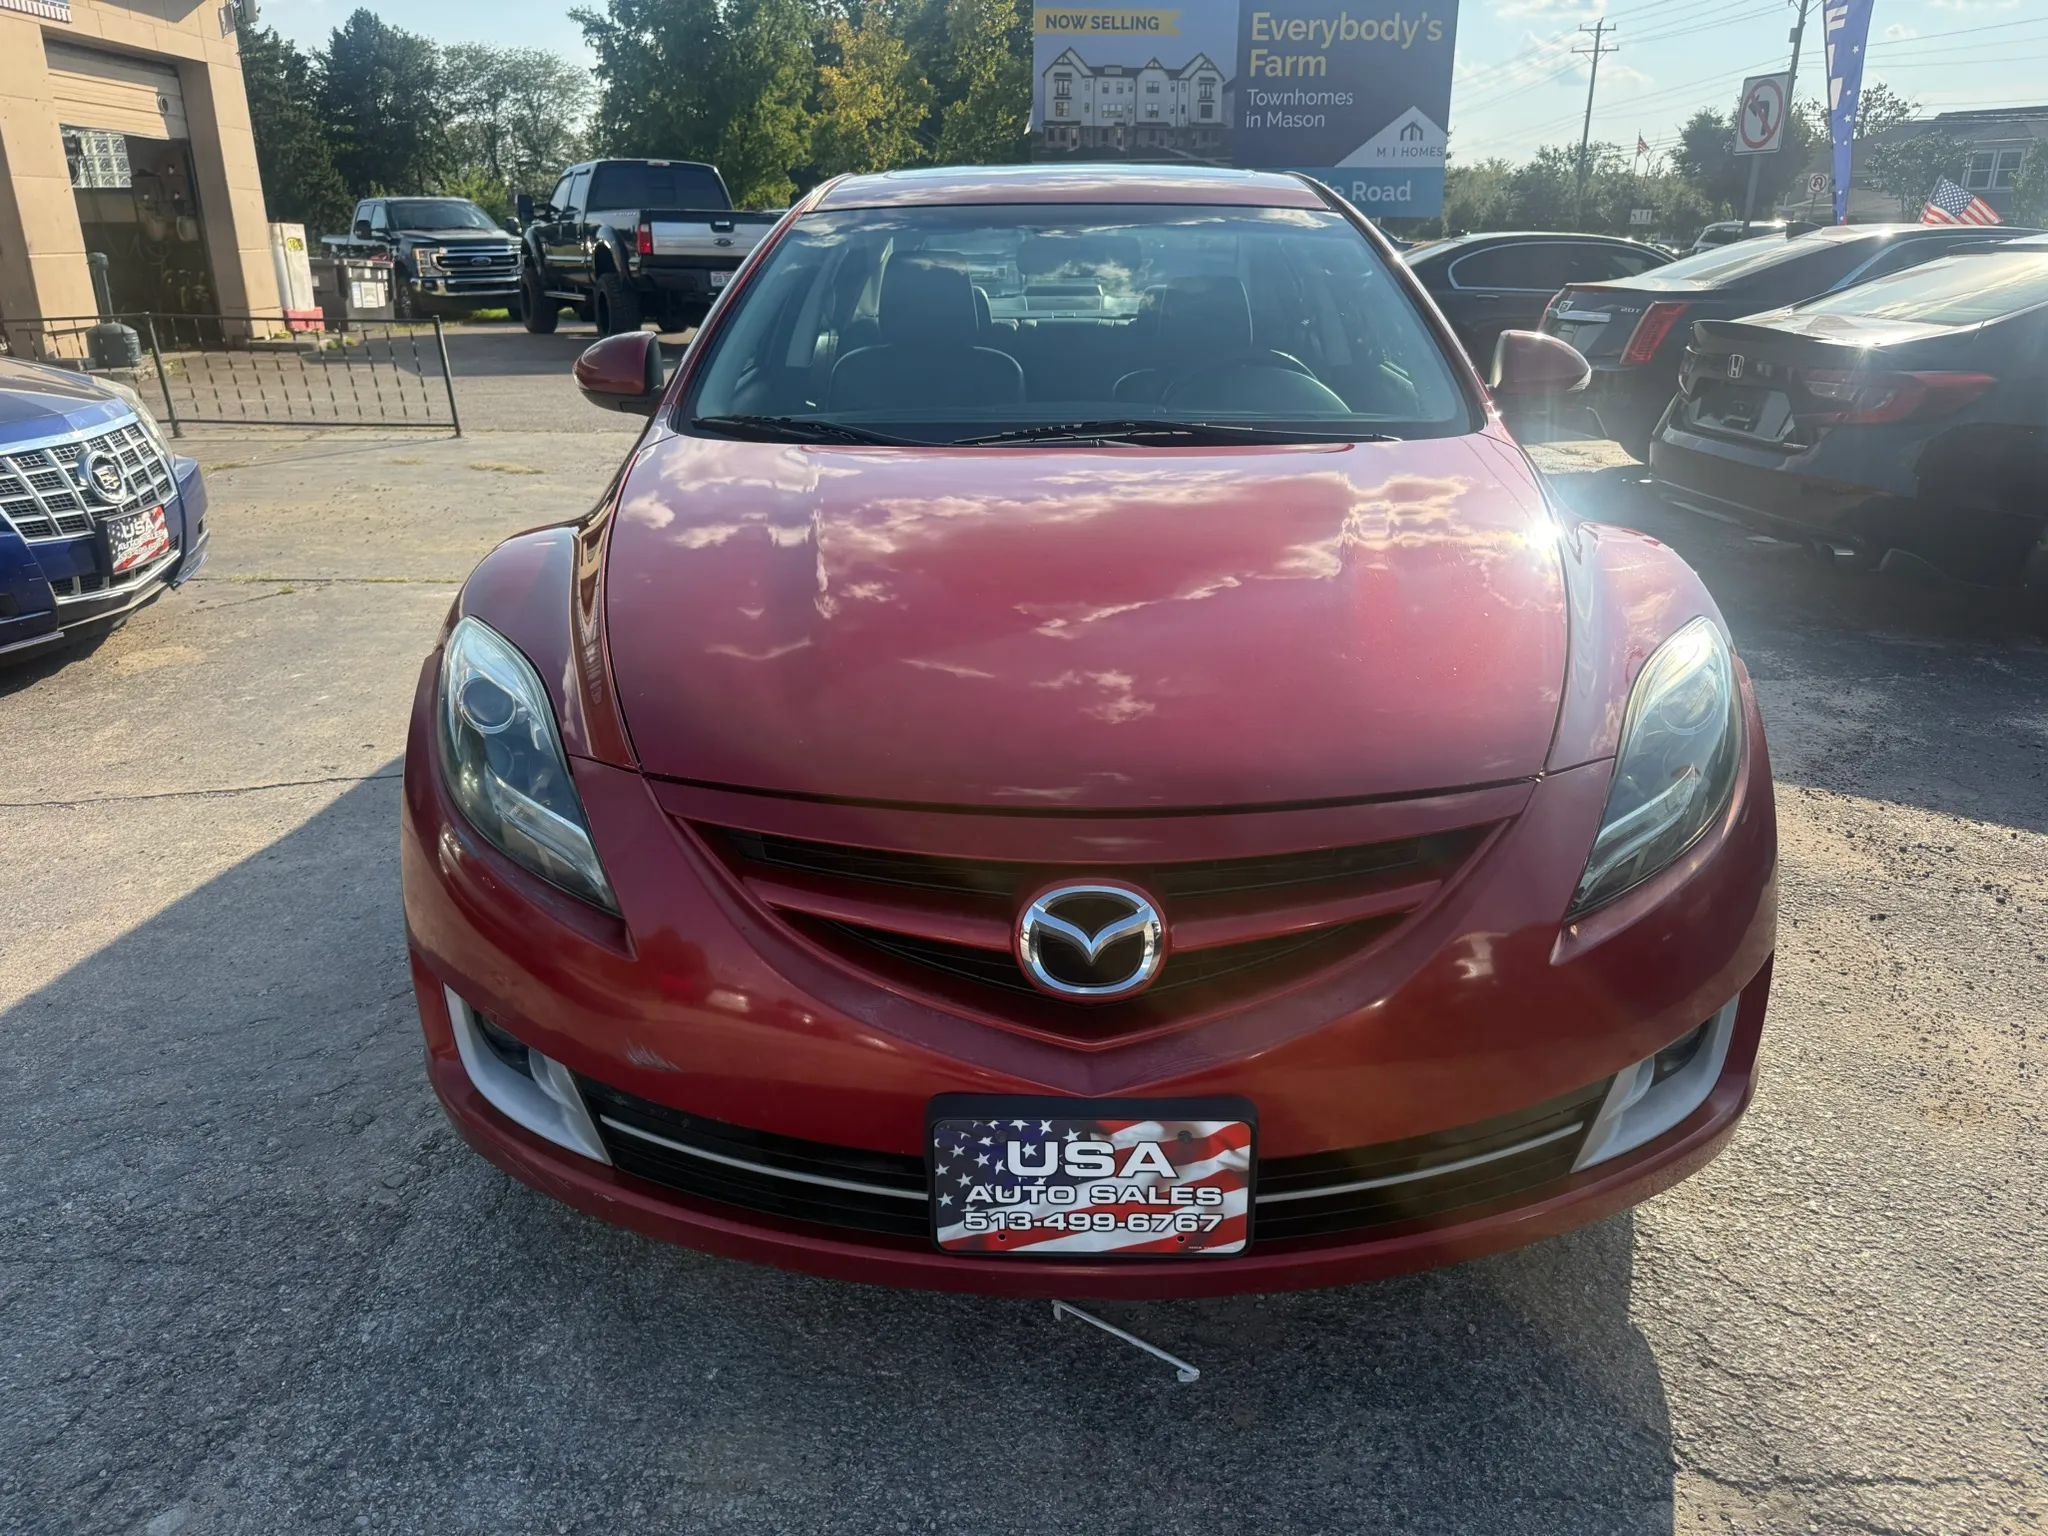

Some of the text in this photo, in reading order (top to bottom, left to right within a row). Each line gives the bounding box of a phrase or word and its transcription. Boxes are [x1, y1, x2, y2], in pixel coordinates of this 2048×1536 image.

[1045, 14, 1160, 30] NOW SELLING
[1251, 11, 1443, 49] Everybody's
[1249, 48, 1327, 77] Farm
[1247, 88, 1354, 106] Townhomes
[1245, 111, 1326, 128] in Mason
[1400, 146, 1443, 158] HOMES
[1351, 180, 1412, 202] Road
[119, 518, 155, 539] USA
[1006, 1140, 1179, 1178] USA
[964, 1184, 1224, 1206] AUTO SALES
[963, 1211, 1225, 1233] 513-499-6767
